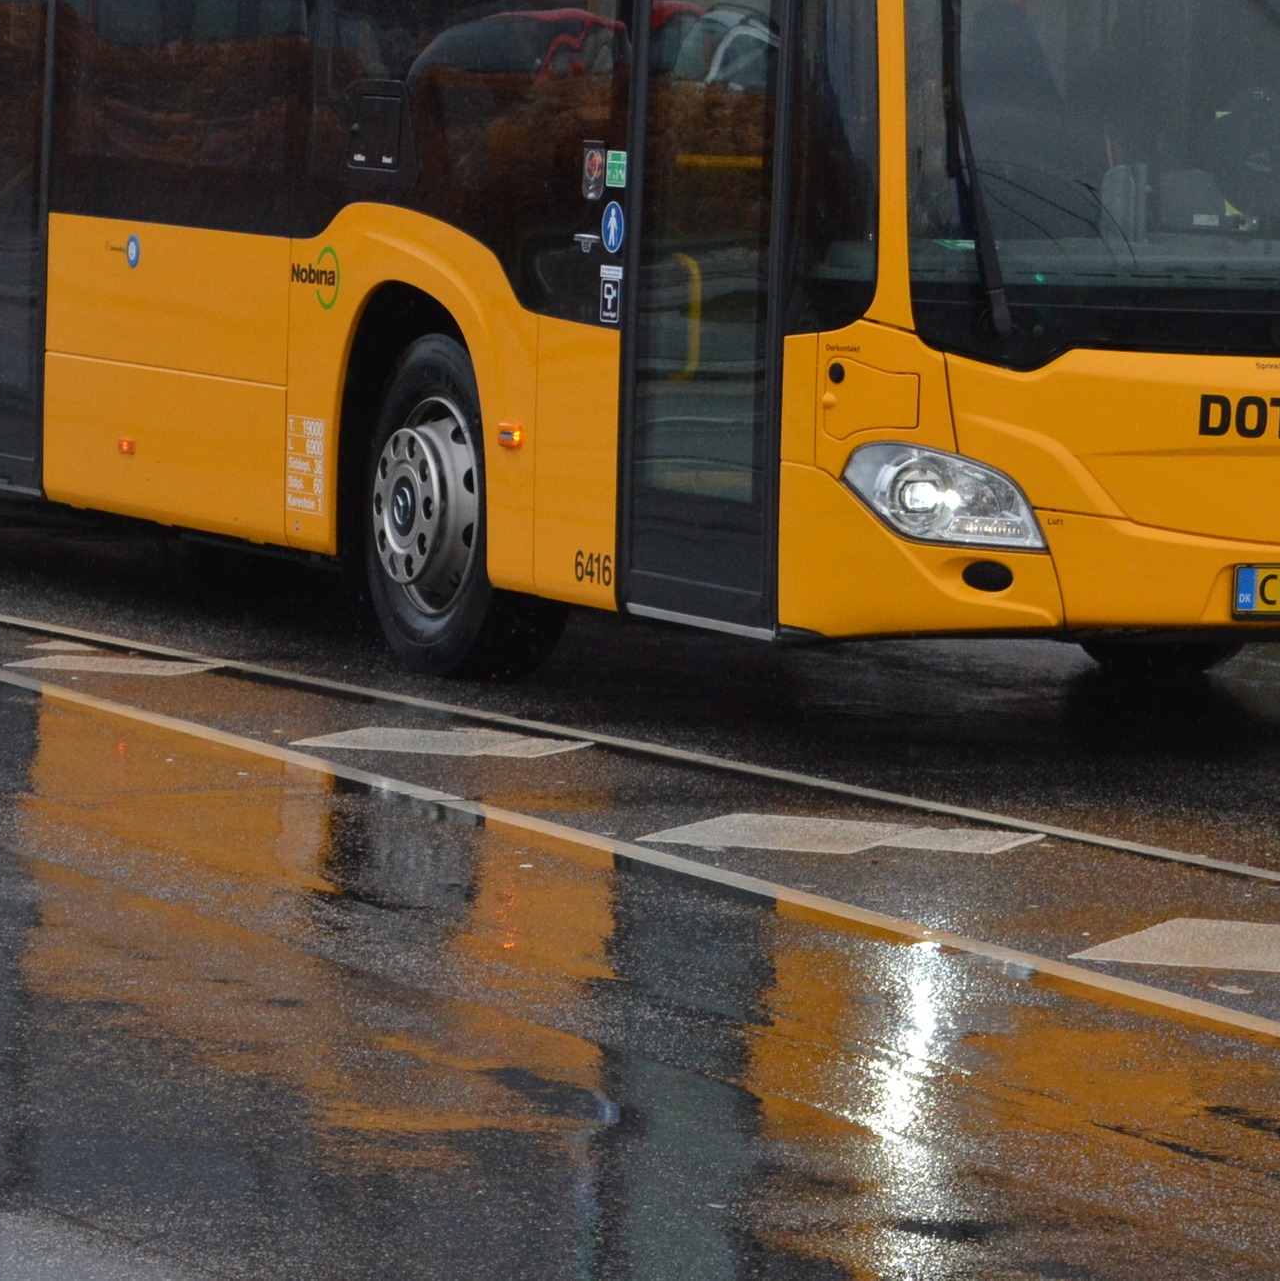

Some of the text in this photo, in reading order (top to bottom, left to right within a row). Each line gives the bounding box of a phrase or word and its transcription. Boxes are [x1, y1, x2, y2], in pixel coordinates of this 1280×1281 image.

[291, 263, 335, 286] Nobina
[575, 550, 612, 587] 6416
[1238, 594, 1252, 604] DK
